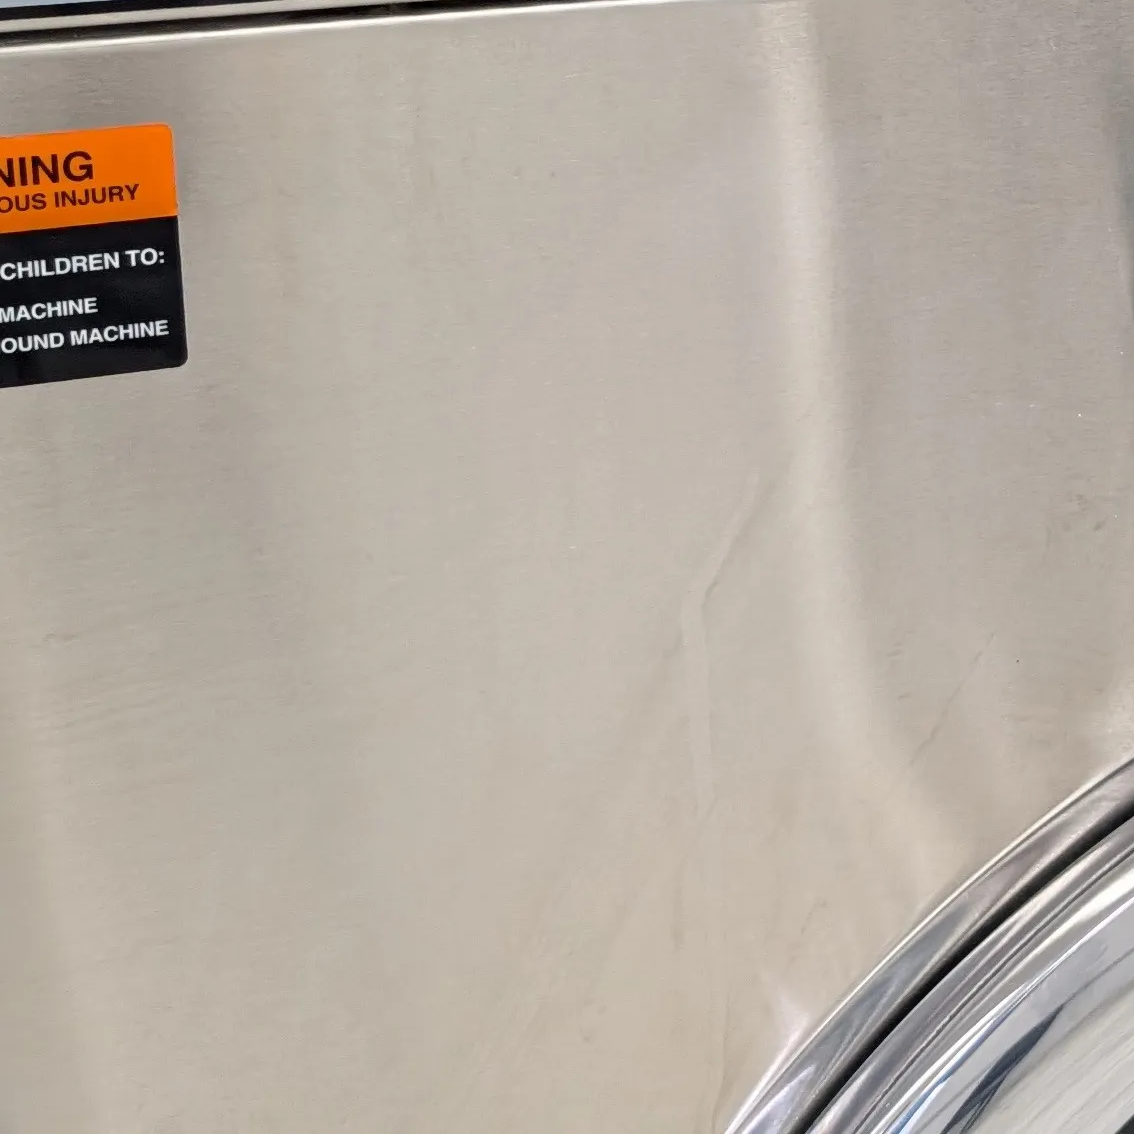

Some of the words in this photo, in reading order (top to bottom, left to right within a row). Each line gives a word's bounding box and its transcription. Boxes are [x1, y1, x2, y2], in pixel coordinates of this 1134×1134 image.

[0, 192, 47, 213] OUS
[54, 183, 140, 208] INJURY
[0, 251, 120, 281] CHILDREN
[124, 247, 165, 267] TO:
[0, 297, 98, 323] MACHINE
[0, 332, 65, 354] OUND
[70, 319, 170, 347] MACHINE
